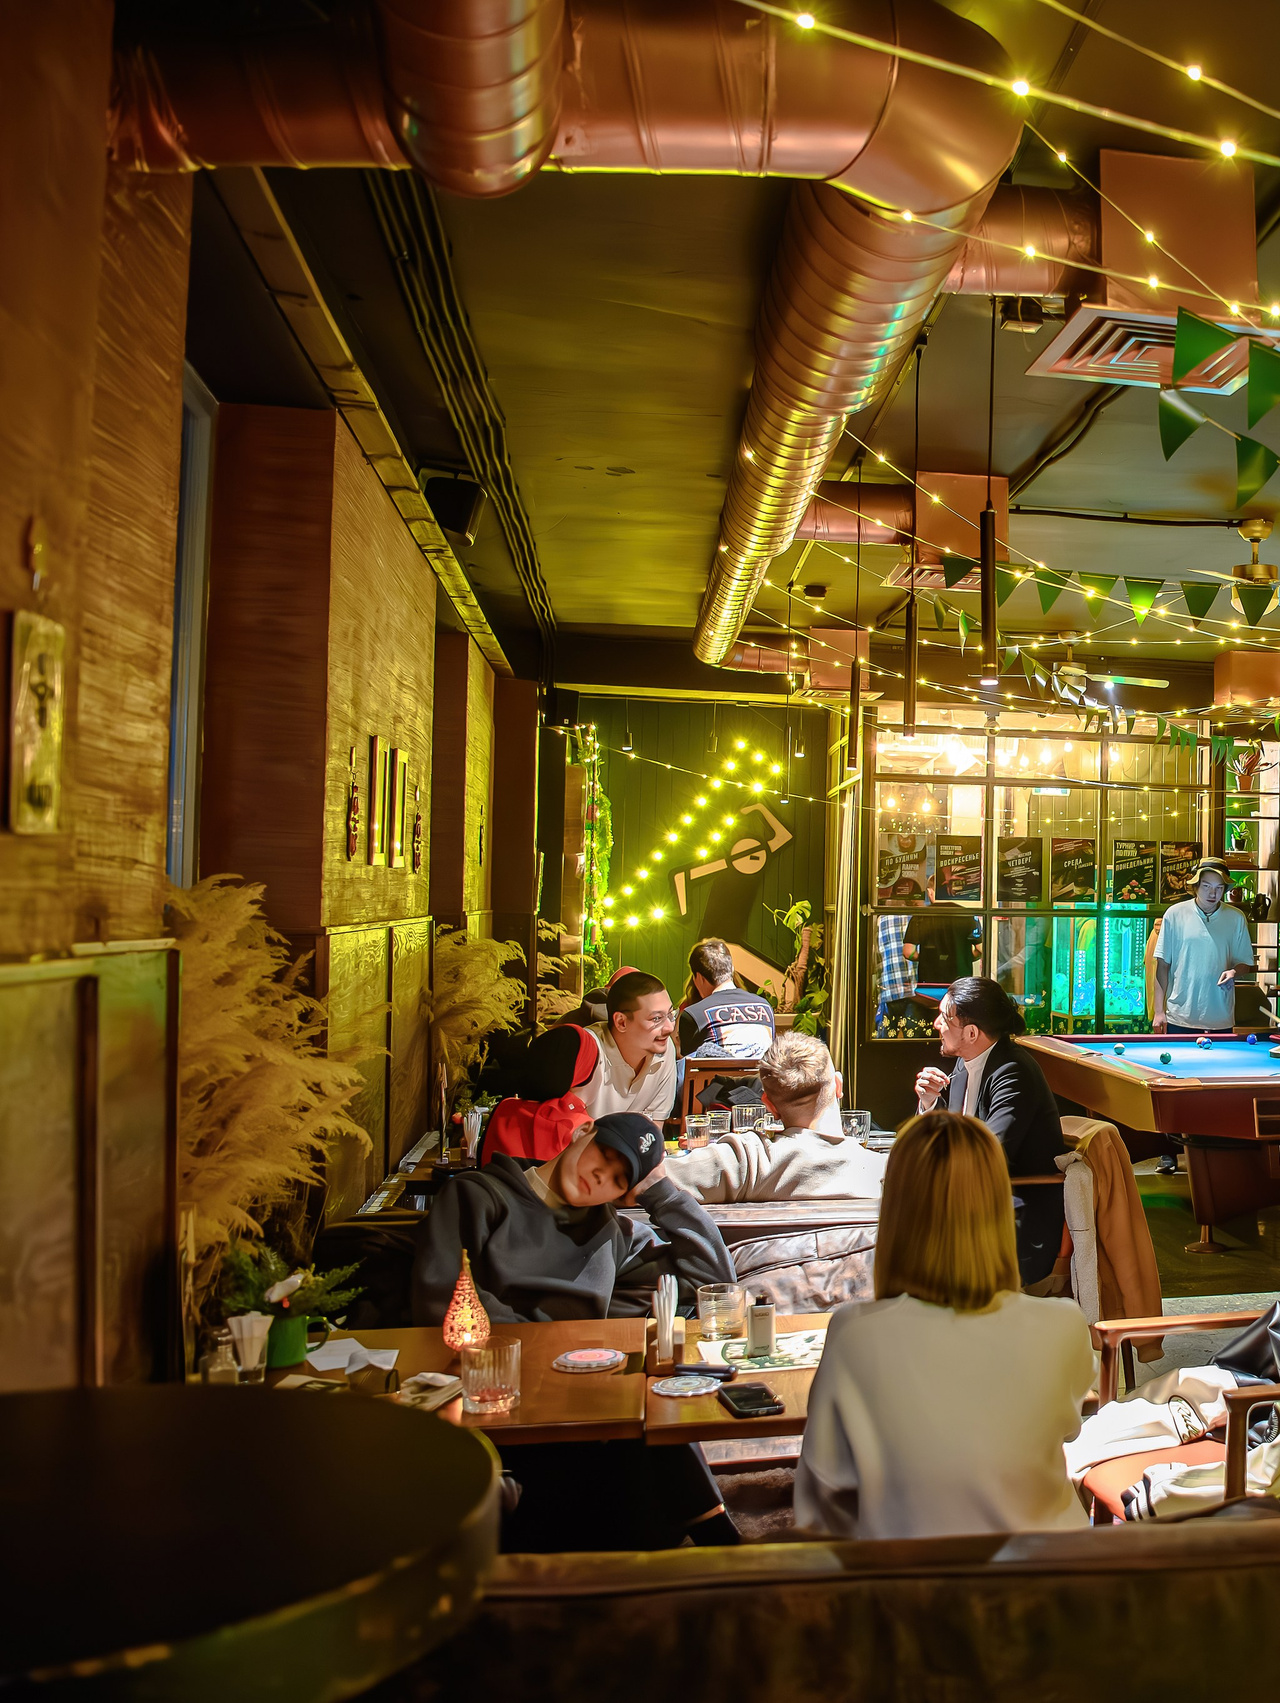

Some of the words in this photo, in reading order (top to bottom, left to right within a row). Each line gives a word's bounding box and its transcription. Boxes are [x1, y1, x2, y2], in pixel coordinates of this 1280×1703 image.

[1123, 849, 1138, 857] ПУЛУ
[885, 858, 894, 866] ПО
[939, 852, 980, 867] ВОСКРЕСЕНЬЕ
[1007, 856, 1032, 867] ЧЕТВЕРГ
[1063, 857, 1083, 868] СРЕДА
[1115, 856, 1154, 872] ПОНЕДЕЛЬНИК
[714, 1006, 771, 1024] CASA
